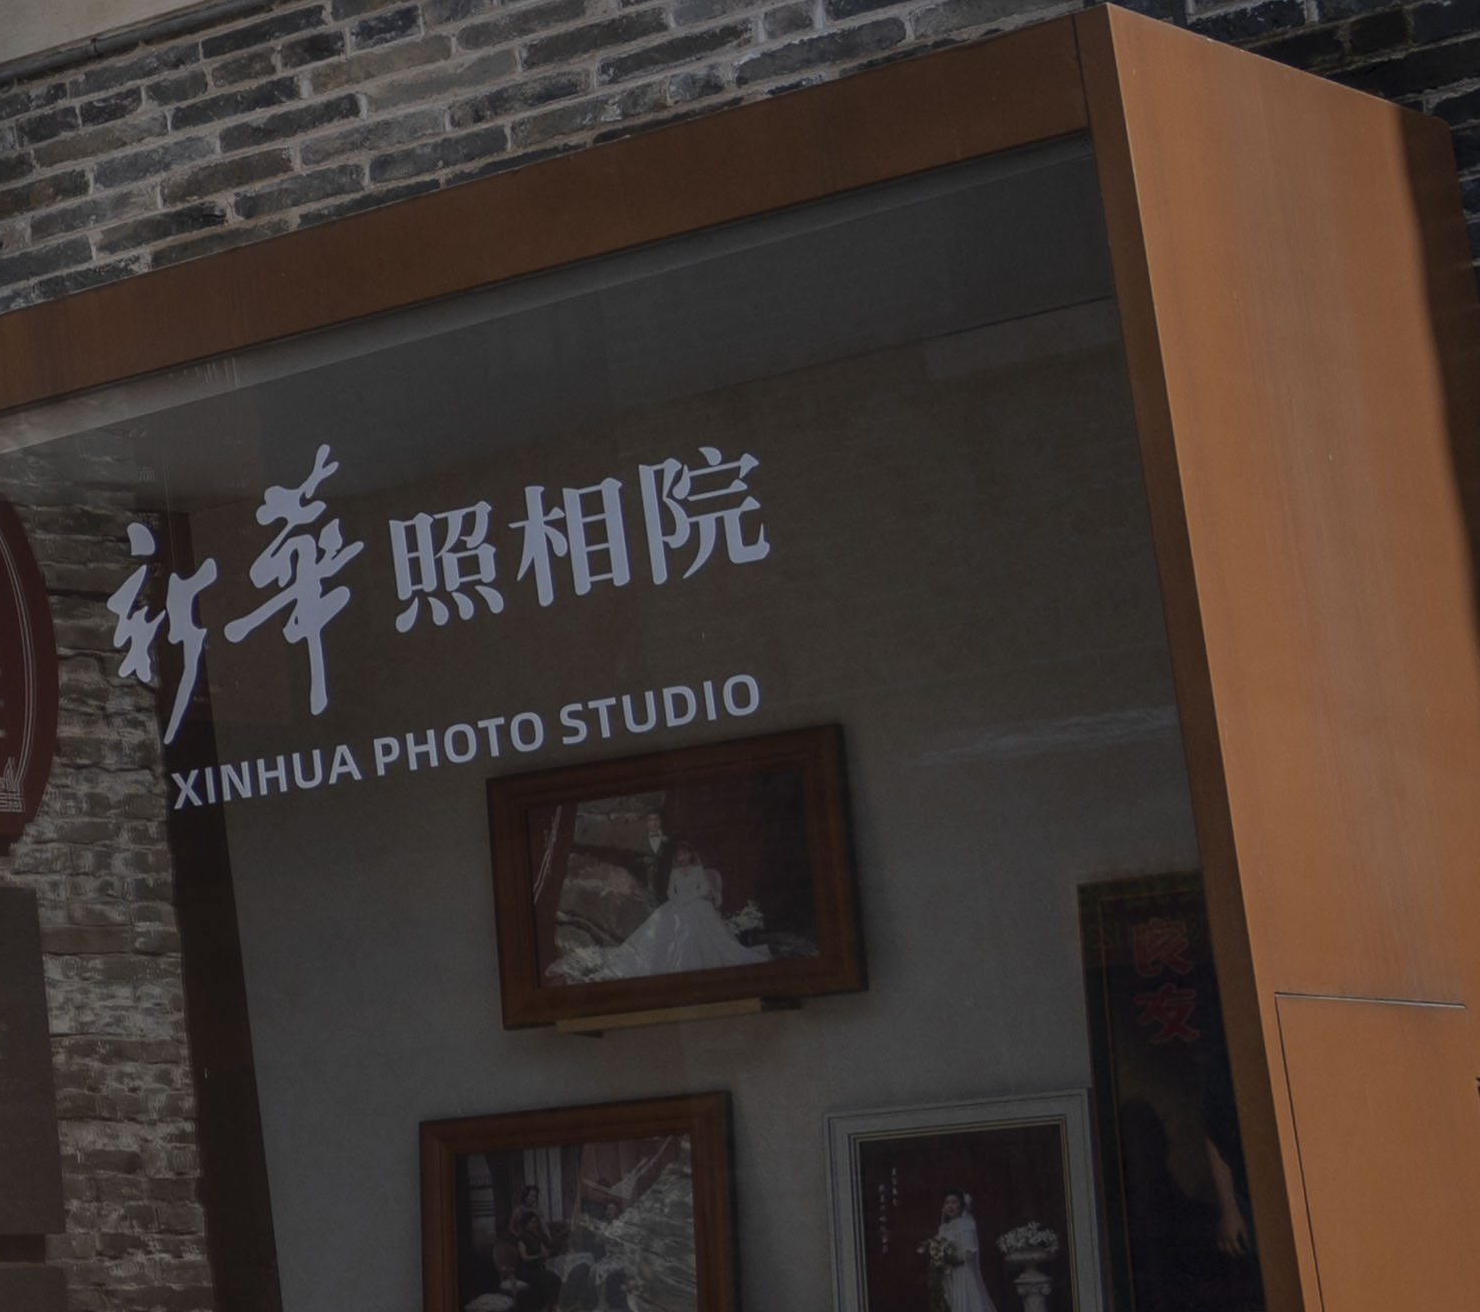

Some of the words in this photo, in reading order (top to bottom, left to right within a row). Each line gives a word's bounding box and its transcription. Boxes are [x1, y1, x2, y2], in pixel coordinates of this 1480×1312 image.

[171, 742, 360, 811] XINHUA
[375, 708, 545, 775] PHOTO
[559, 674, 762, 746] STUDIO
